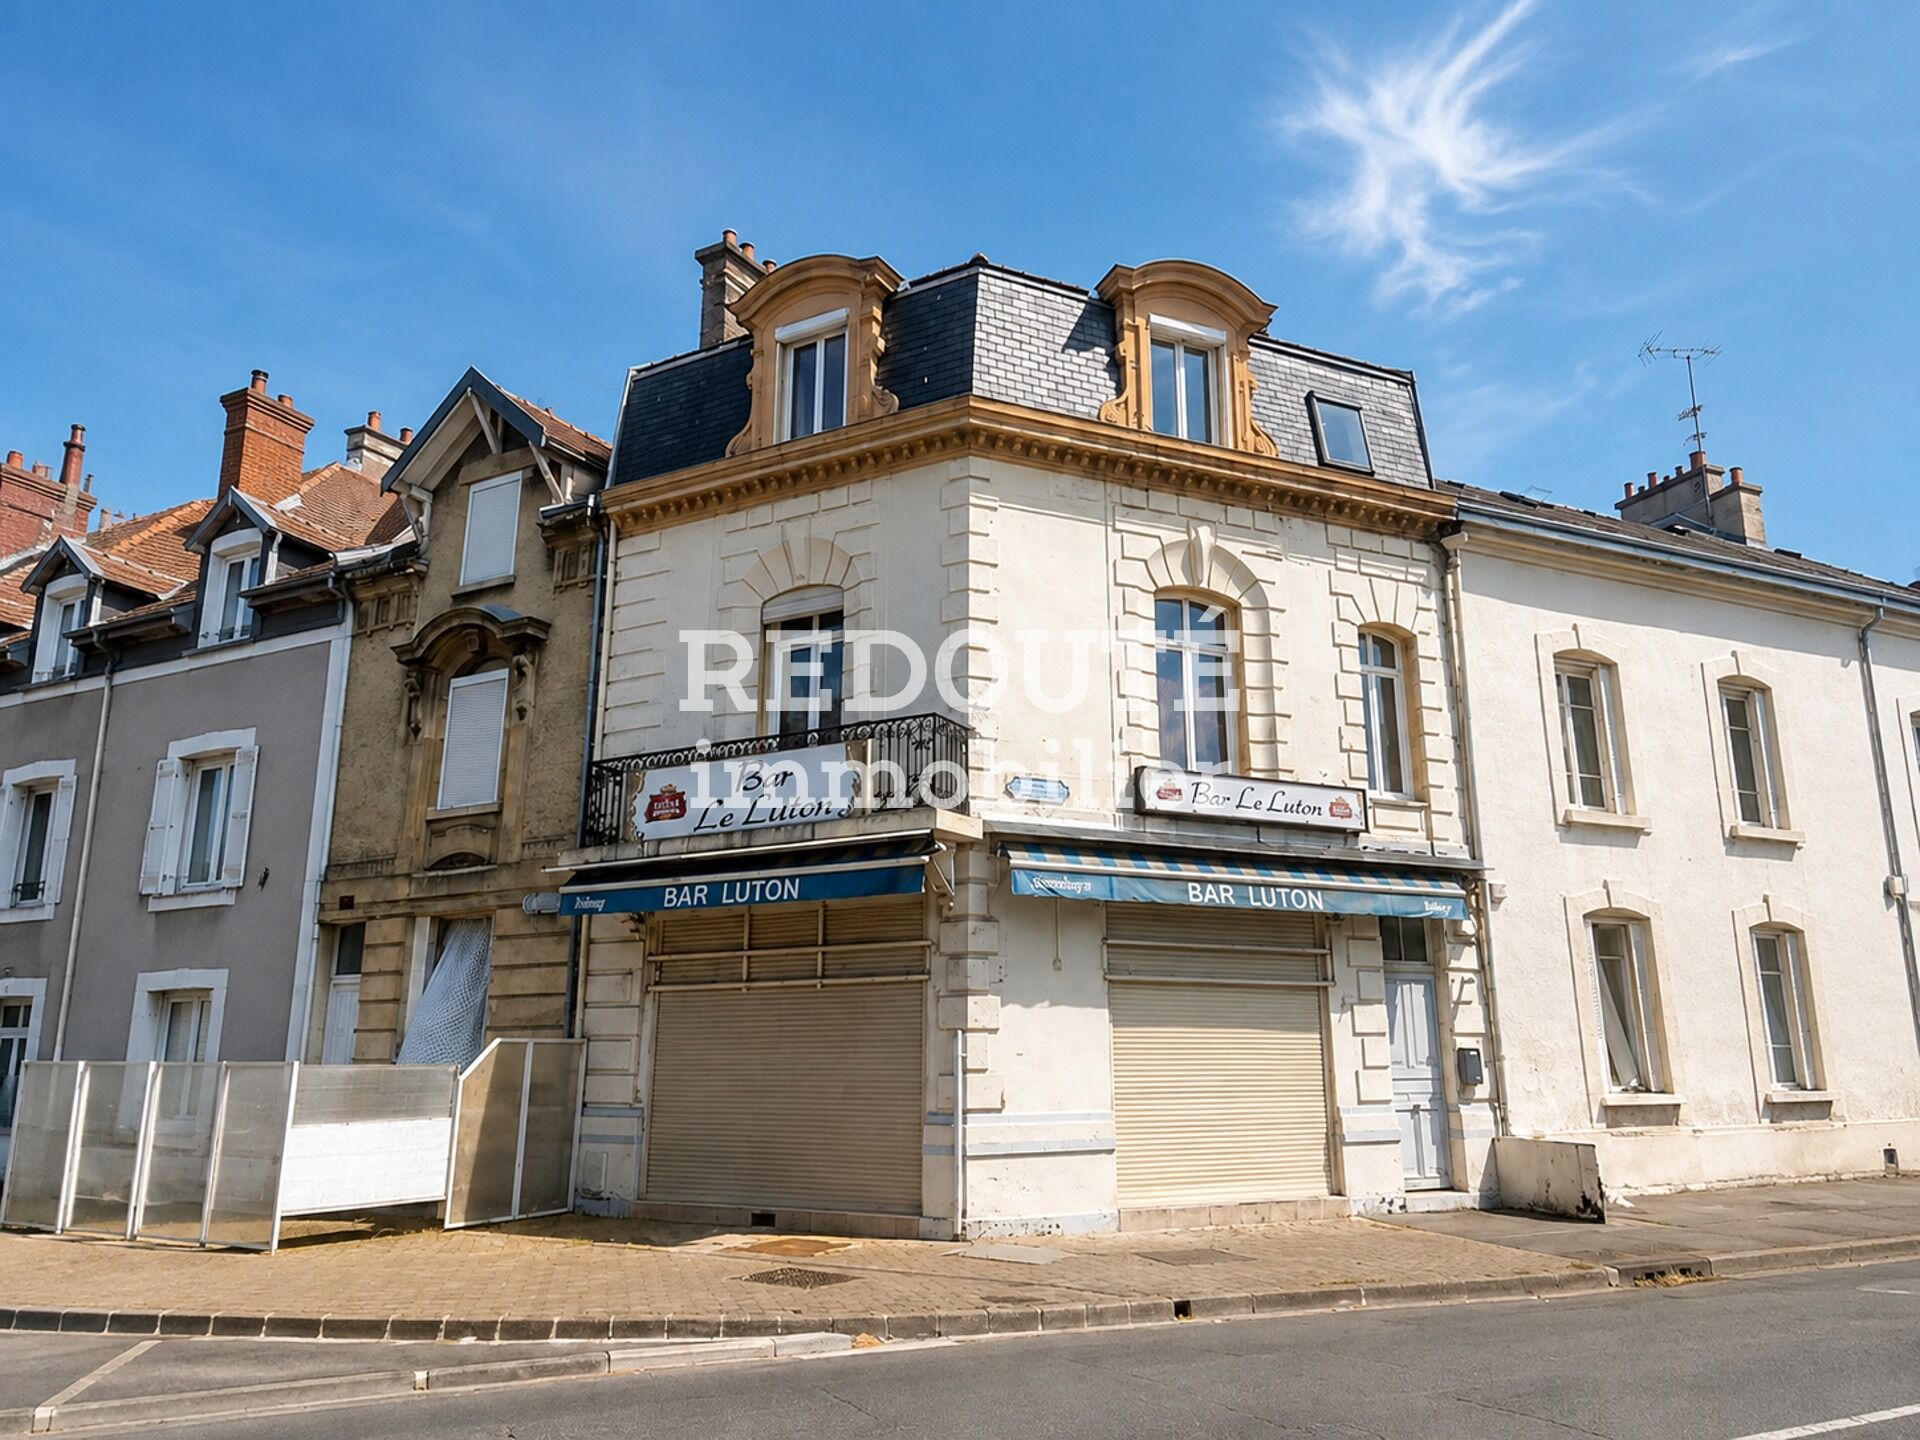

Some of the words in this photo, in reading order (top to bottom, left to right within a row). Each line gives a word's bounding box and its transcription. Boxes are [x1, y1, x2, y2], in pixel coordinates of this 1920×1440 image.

[735, 760, 793, 792] Bar
[693, 799, 734, 832] Le
[742, 793, 832, 825] Luton
[1191, 781, 1231, 806] Bar
[1235, 785, 1262, 811] Le
[1266, 790, 1323, 816] Luton
[664, 884, 708, 907] BAR
[722, 878, 799, 904] LUTON
[1187, 882, 1236, 905] BAR
[1248, 885, 1324, 910] LUTON
